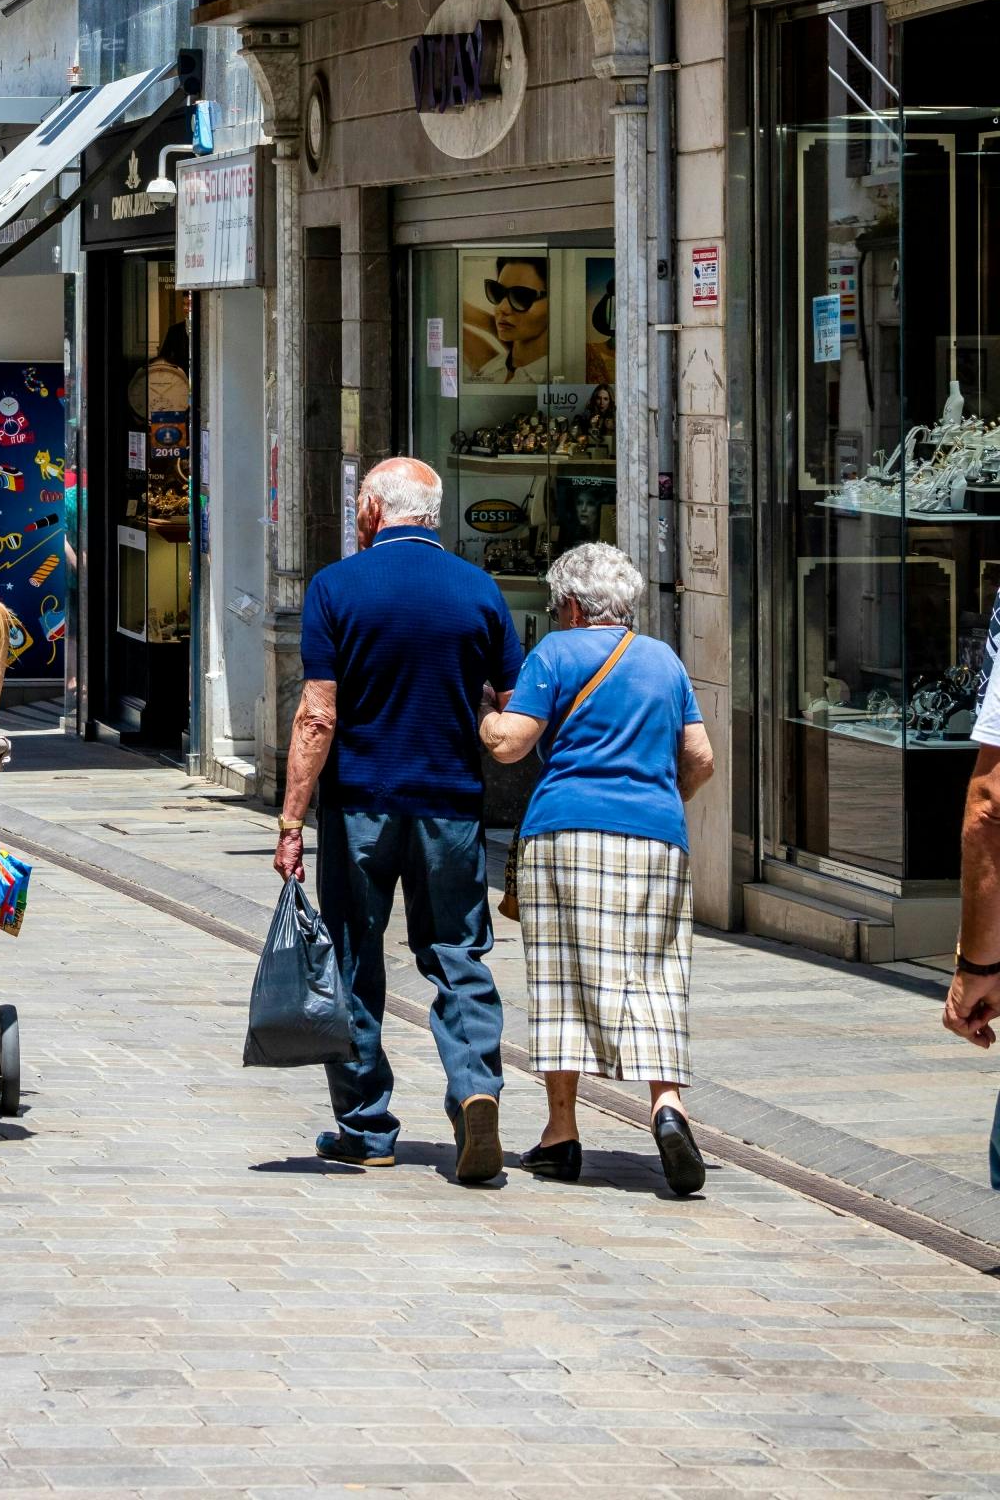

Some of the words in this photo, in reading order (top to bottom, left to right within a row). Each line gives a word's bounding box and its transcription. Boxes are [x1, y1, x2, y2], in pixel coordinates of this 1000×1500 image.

[410, 20, 488, 113] VIJAY
[16, 433, 26, 443] UP
[155, 447, 180, 457] 2016
[470, 510, 511, 523] FOSSI
